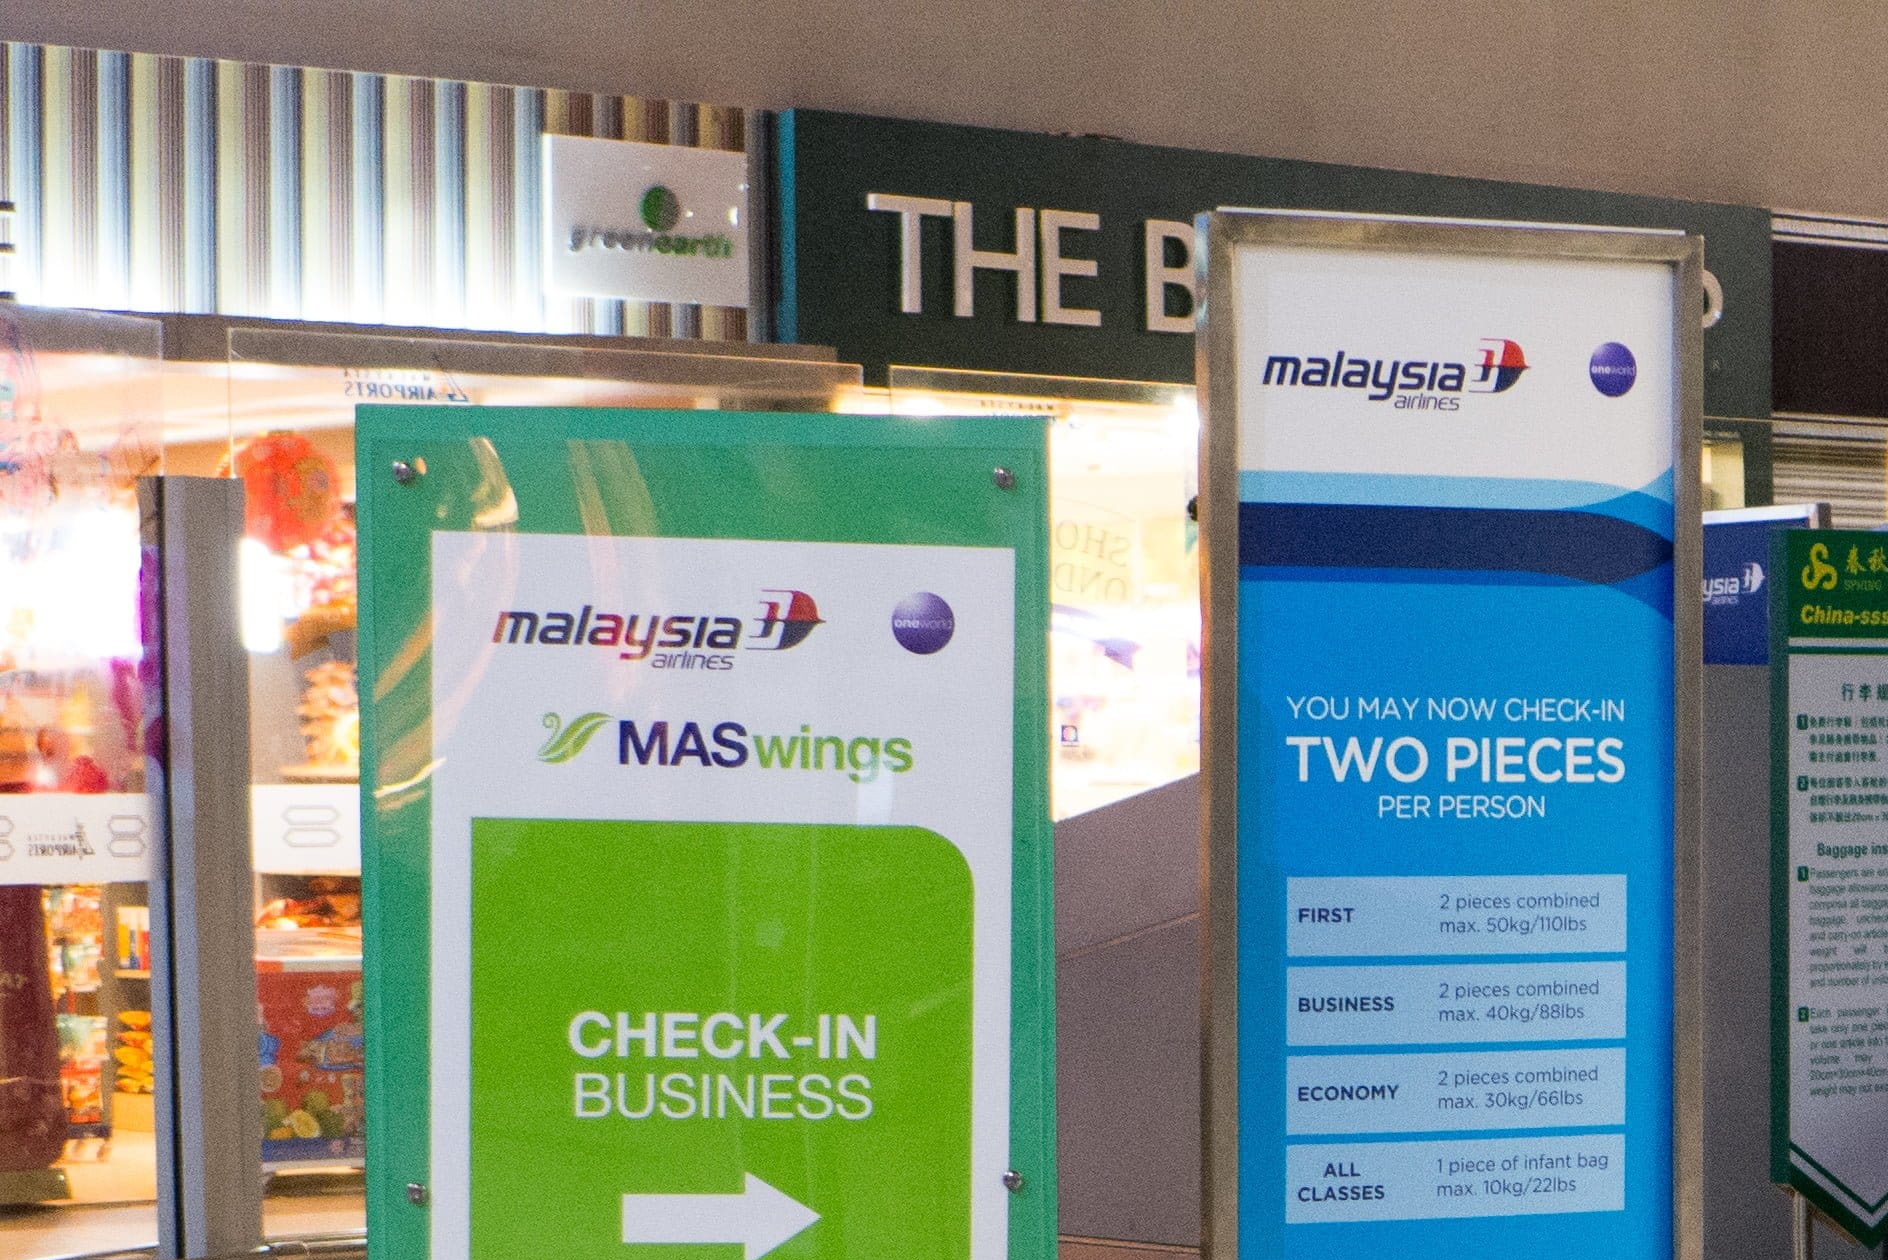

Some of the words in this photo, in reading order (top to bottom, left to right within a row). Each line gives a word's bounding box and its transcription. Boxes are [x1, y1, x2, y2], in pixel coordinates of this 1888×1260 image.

[866, 192, 1102, 327] THE
[1262, 351, 1467, 400] malaysia
[1394, 393, 1460, 411] airlines
[491, 605, 743, 661] malaysia
[652, 650, 736, 671] airlines
[1286, 695, 1349, 721] YOU
[1358, 696, 1420, 721] MAY
[1428, 697, 1497, 721] NOW
[1504, 697, 1625, 722] CHECK-IN
[617, 720, 915, 784] MASwings
[1286, 736, 1429, 783] TWO
[1446, 736, 1626, 784] PIECES
[1378, 795, 1431, 819] PER
[1439, 795, 1546, 819] PERSON
[1816, 843, 1868, 860] Baggage
[1439, 894, 1450, 909] 2
[1456, 894, 1512, 914] pieces
[1516, 892, 1601, 910] combined
[1298, 907, 1356, 924] FIRST
[1439, 919, 1482, 933] max.
[1486, 915, 1588, 936] 50kg/110lbs
[1438, 983, 1450, 999] 2
[1455, 982, 1511, 1002] pieces
[1515, 979, 1600, 998] combined
[1297, 996, 1395, 1013] BUSINESS
[1438, 1008, 1481, 1022] max.
[1485, 1003, 1585, 1024] 40kg/88lbs
[568, 1011, 877, 1059] CHECK-IN
[1437, 1071, 1448, 1086] 2
[1454, 1070, 1510, 1089] pieces
[1514, 1066, 1599, 1085] combined
[574, 1072, 874, 1120] BUSINESS
[1297, 1084, 1399, 1102] ECONOMY
[1437, 1095, 1479, 1110] max.
[1484, 1090, 1584, 1111] 30kg/66lbs
[1323, 1162, 1361, 1178] ALL
[1437, 1159, 1443, 1174] 1
[1449, 1156, 1495, 1177] piece
[1501, 1155, 1519, 1172] of
[1523, 1154, 1571, 1171] infant
[1577, 1151, 1610, 1171] bag
[1297, 1185, 1386, 1203] CLASSES
[1436, 1183, 1478, 1197] max.
[1483, 1177, 1577, 1198] 10kg/22lbs
